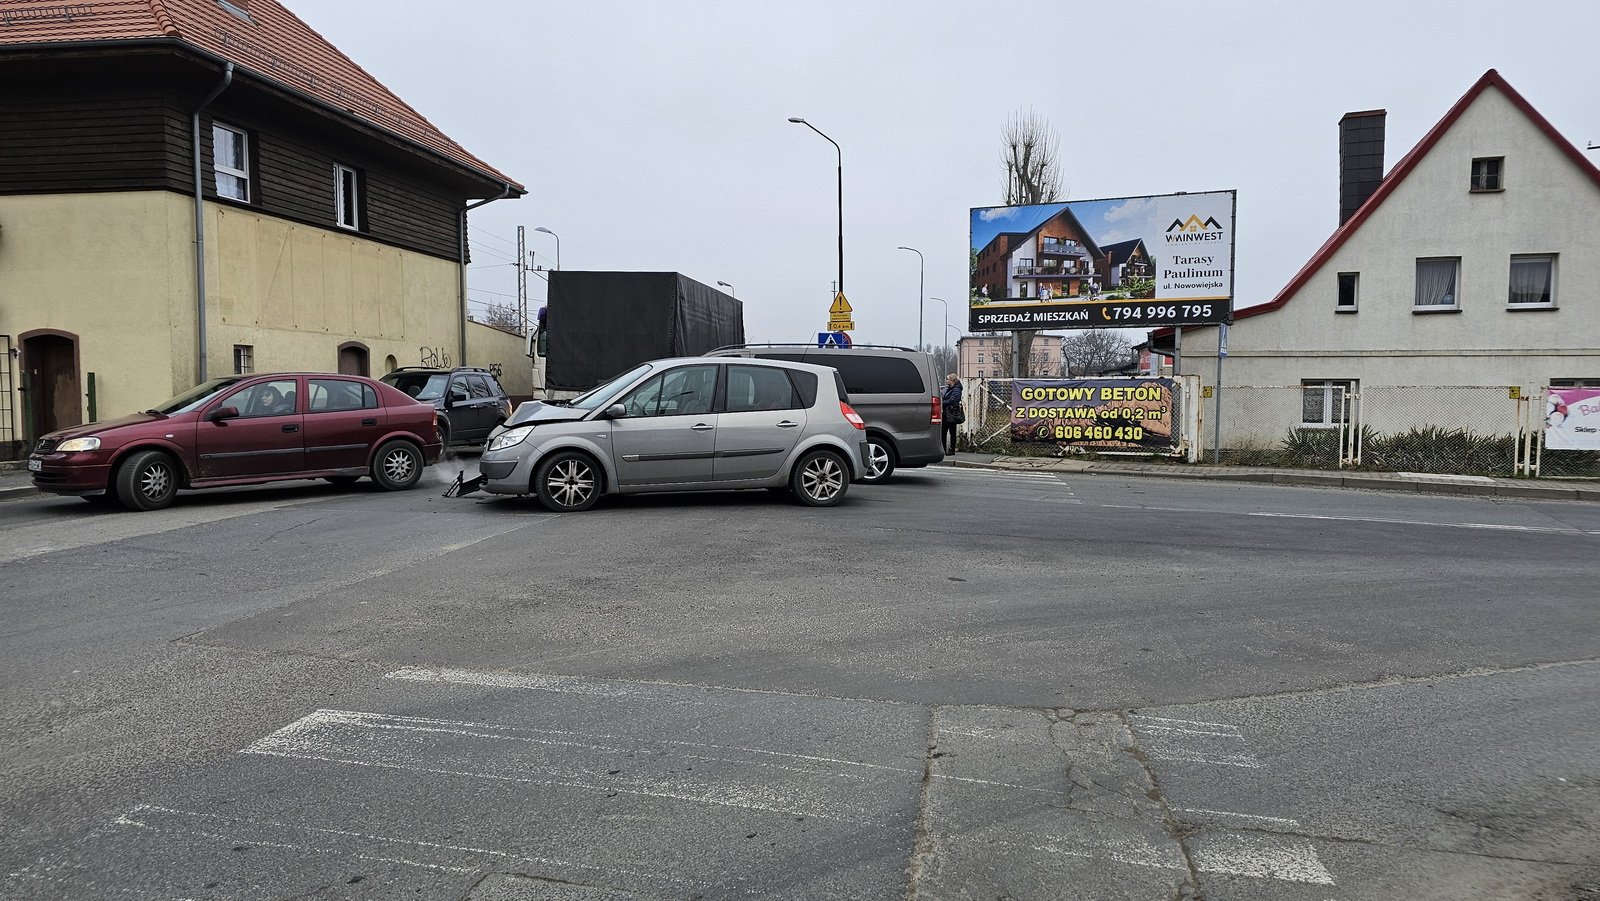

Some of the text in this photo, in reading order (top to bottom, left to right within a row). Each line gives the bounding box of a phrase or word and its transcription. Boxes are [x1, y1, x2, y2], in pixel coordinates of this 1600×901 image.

[1172, 255, 1215, 266] Tarasy
[1164, 268, 1223, 279] Paulinum
[1174, 281, 1223, 290] Nowowiejska
[978, 308, 1089, 324] SPRZEDAŻ MIESZKAŃ
[1113, 304, 1212, 320] 794 996 795
[1021, 387, 1162, 401] GOTOWY BETON
[1015, 407, 1025, 418] Z
[1028, 407, 1097, 422] DOSTAWĄ
[1101, 408, 1118, 419] od
[1122, 408, 1144, 421] 0,2
[1055, 425, 1143, 440] 606 460 430
